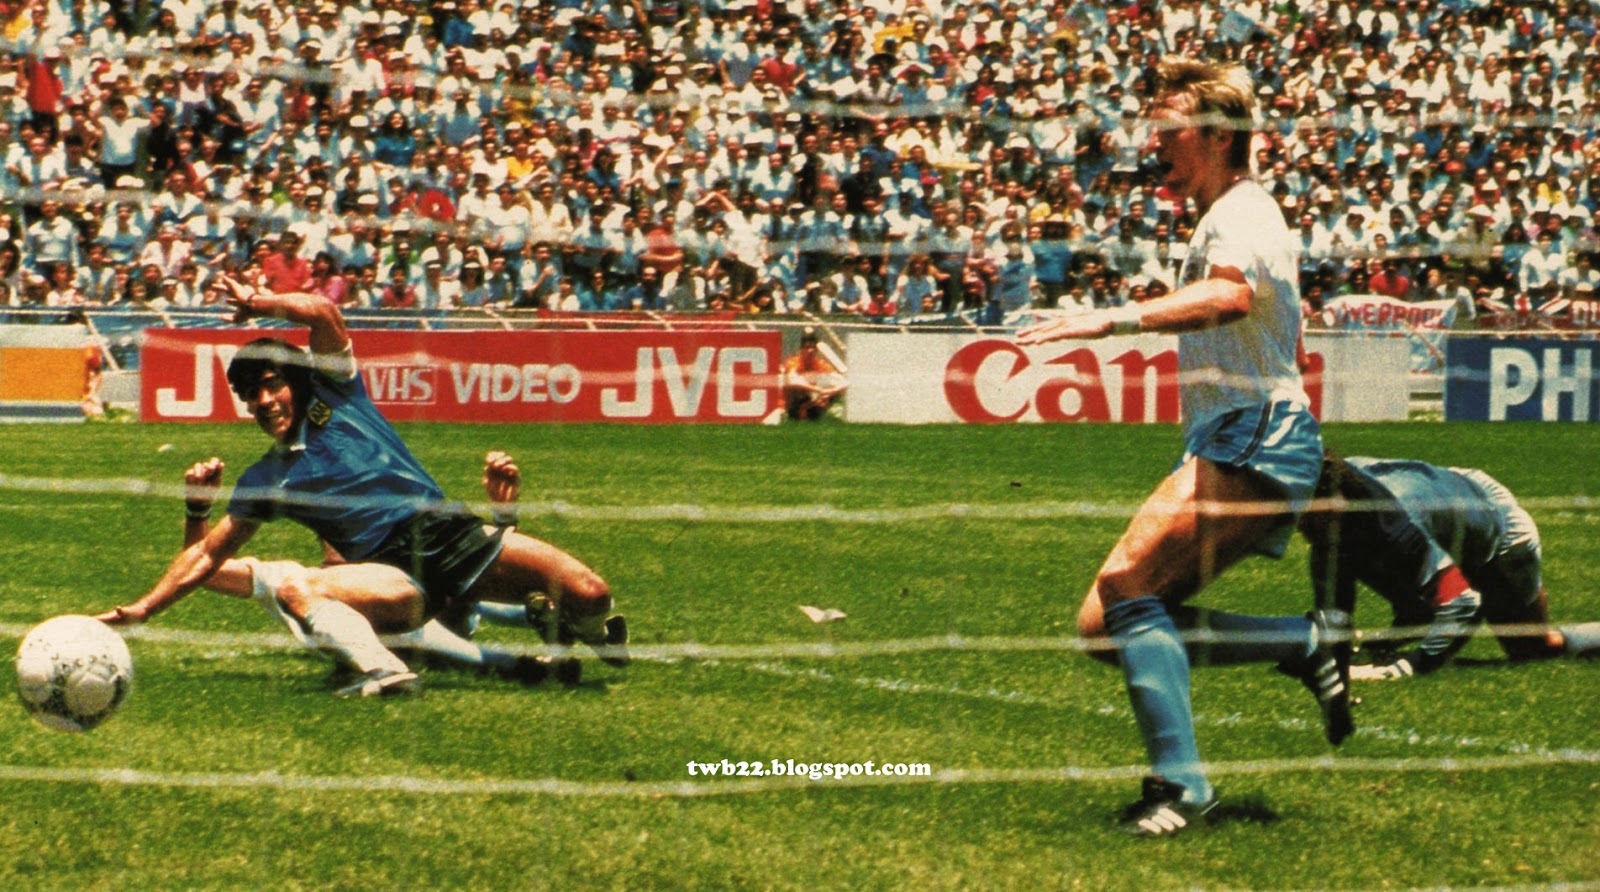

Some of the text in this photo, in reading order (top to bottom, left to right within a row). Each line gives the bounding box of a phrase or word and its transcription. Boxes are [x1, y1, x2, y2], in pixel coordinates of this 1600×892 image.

[368, 367, 432, 400] VHS
[452, 363, 581, 404] VIDEO
[601, 346, 768, 417] JVC
[944, 339, 1323, 423] Can
